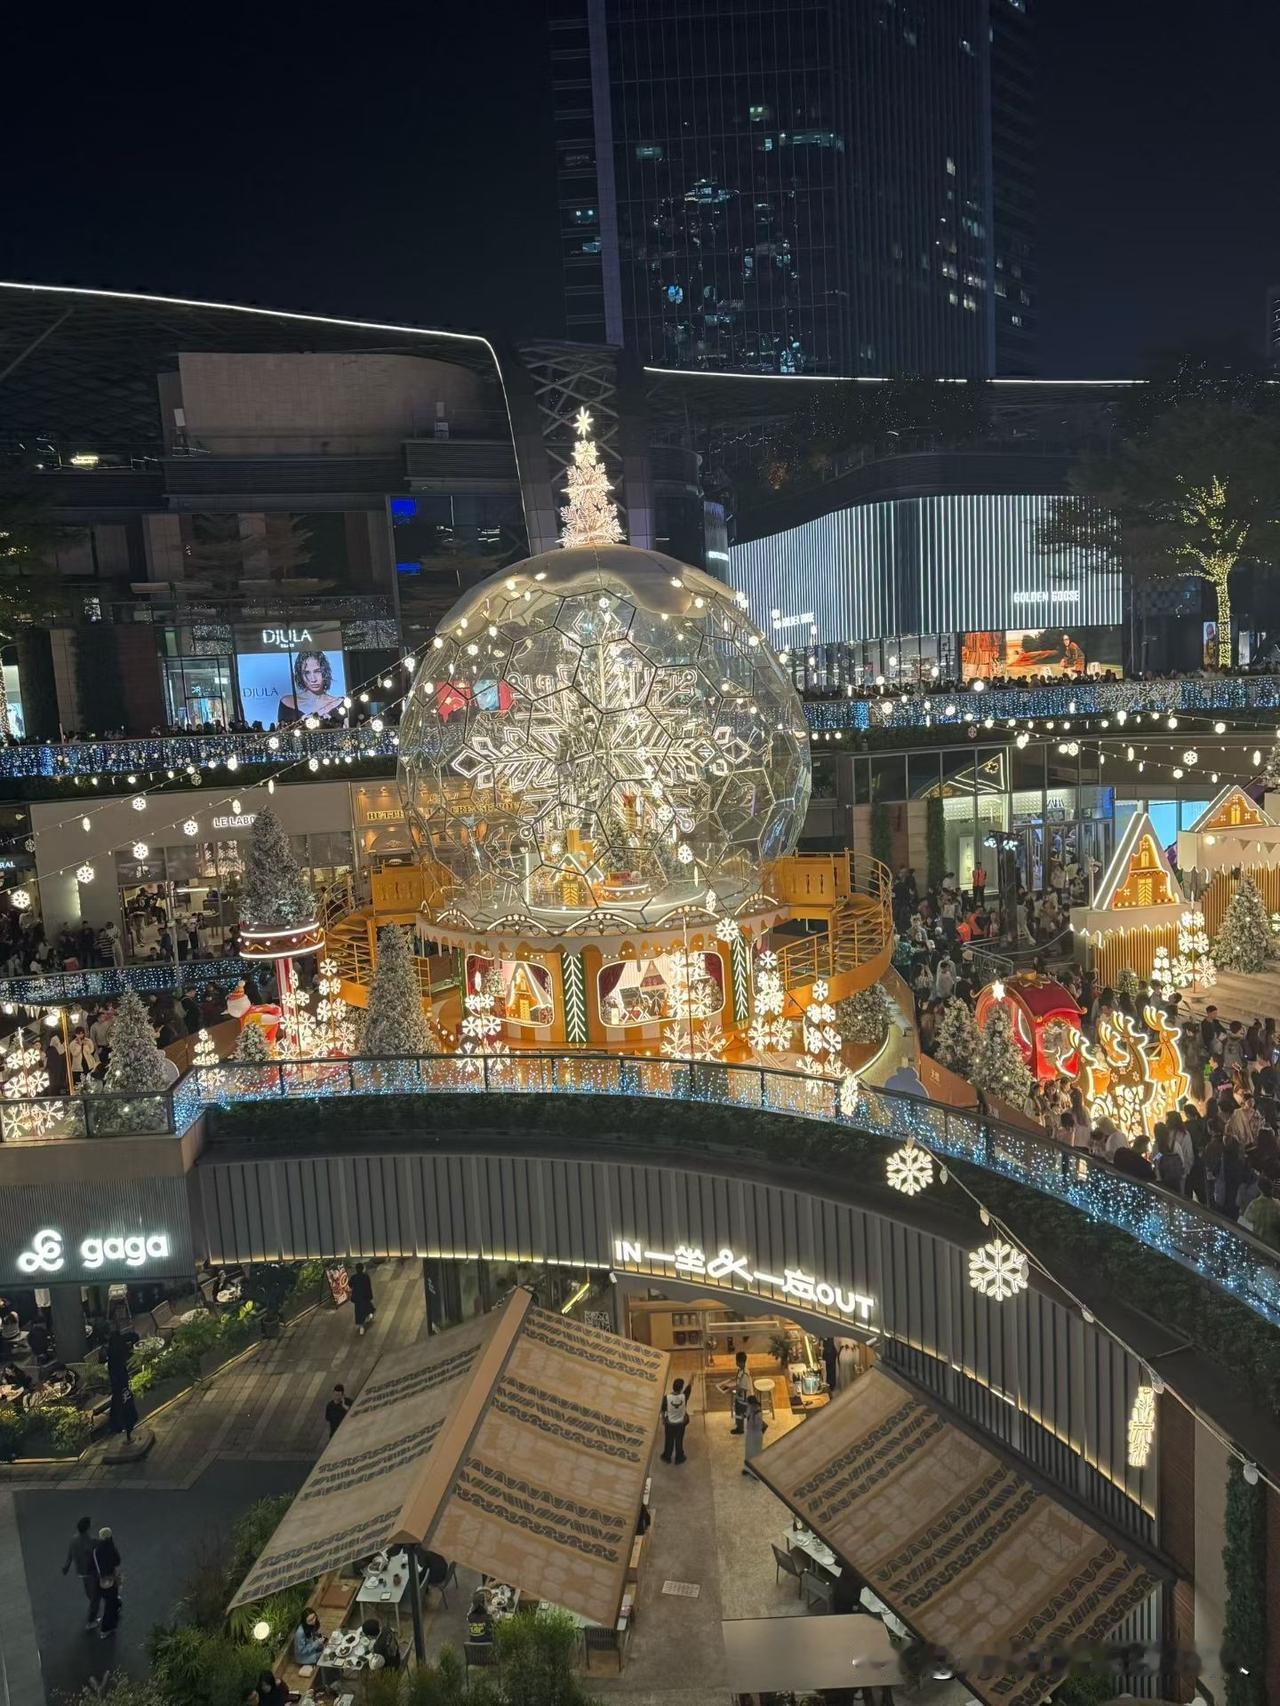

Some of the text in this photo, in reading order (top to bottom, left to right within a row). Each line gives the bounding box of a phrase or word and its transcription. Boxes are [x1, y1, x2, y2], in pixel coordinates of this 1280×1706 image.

[1014, 590, 1080, 604] GOLDEN GOOSE
[262, 628, 313, 645] DJULA
[213, 816, 228, 829] LE
[80, 1234, 169, 1269] gaga
